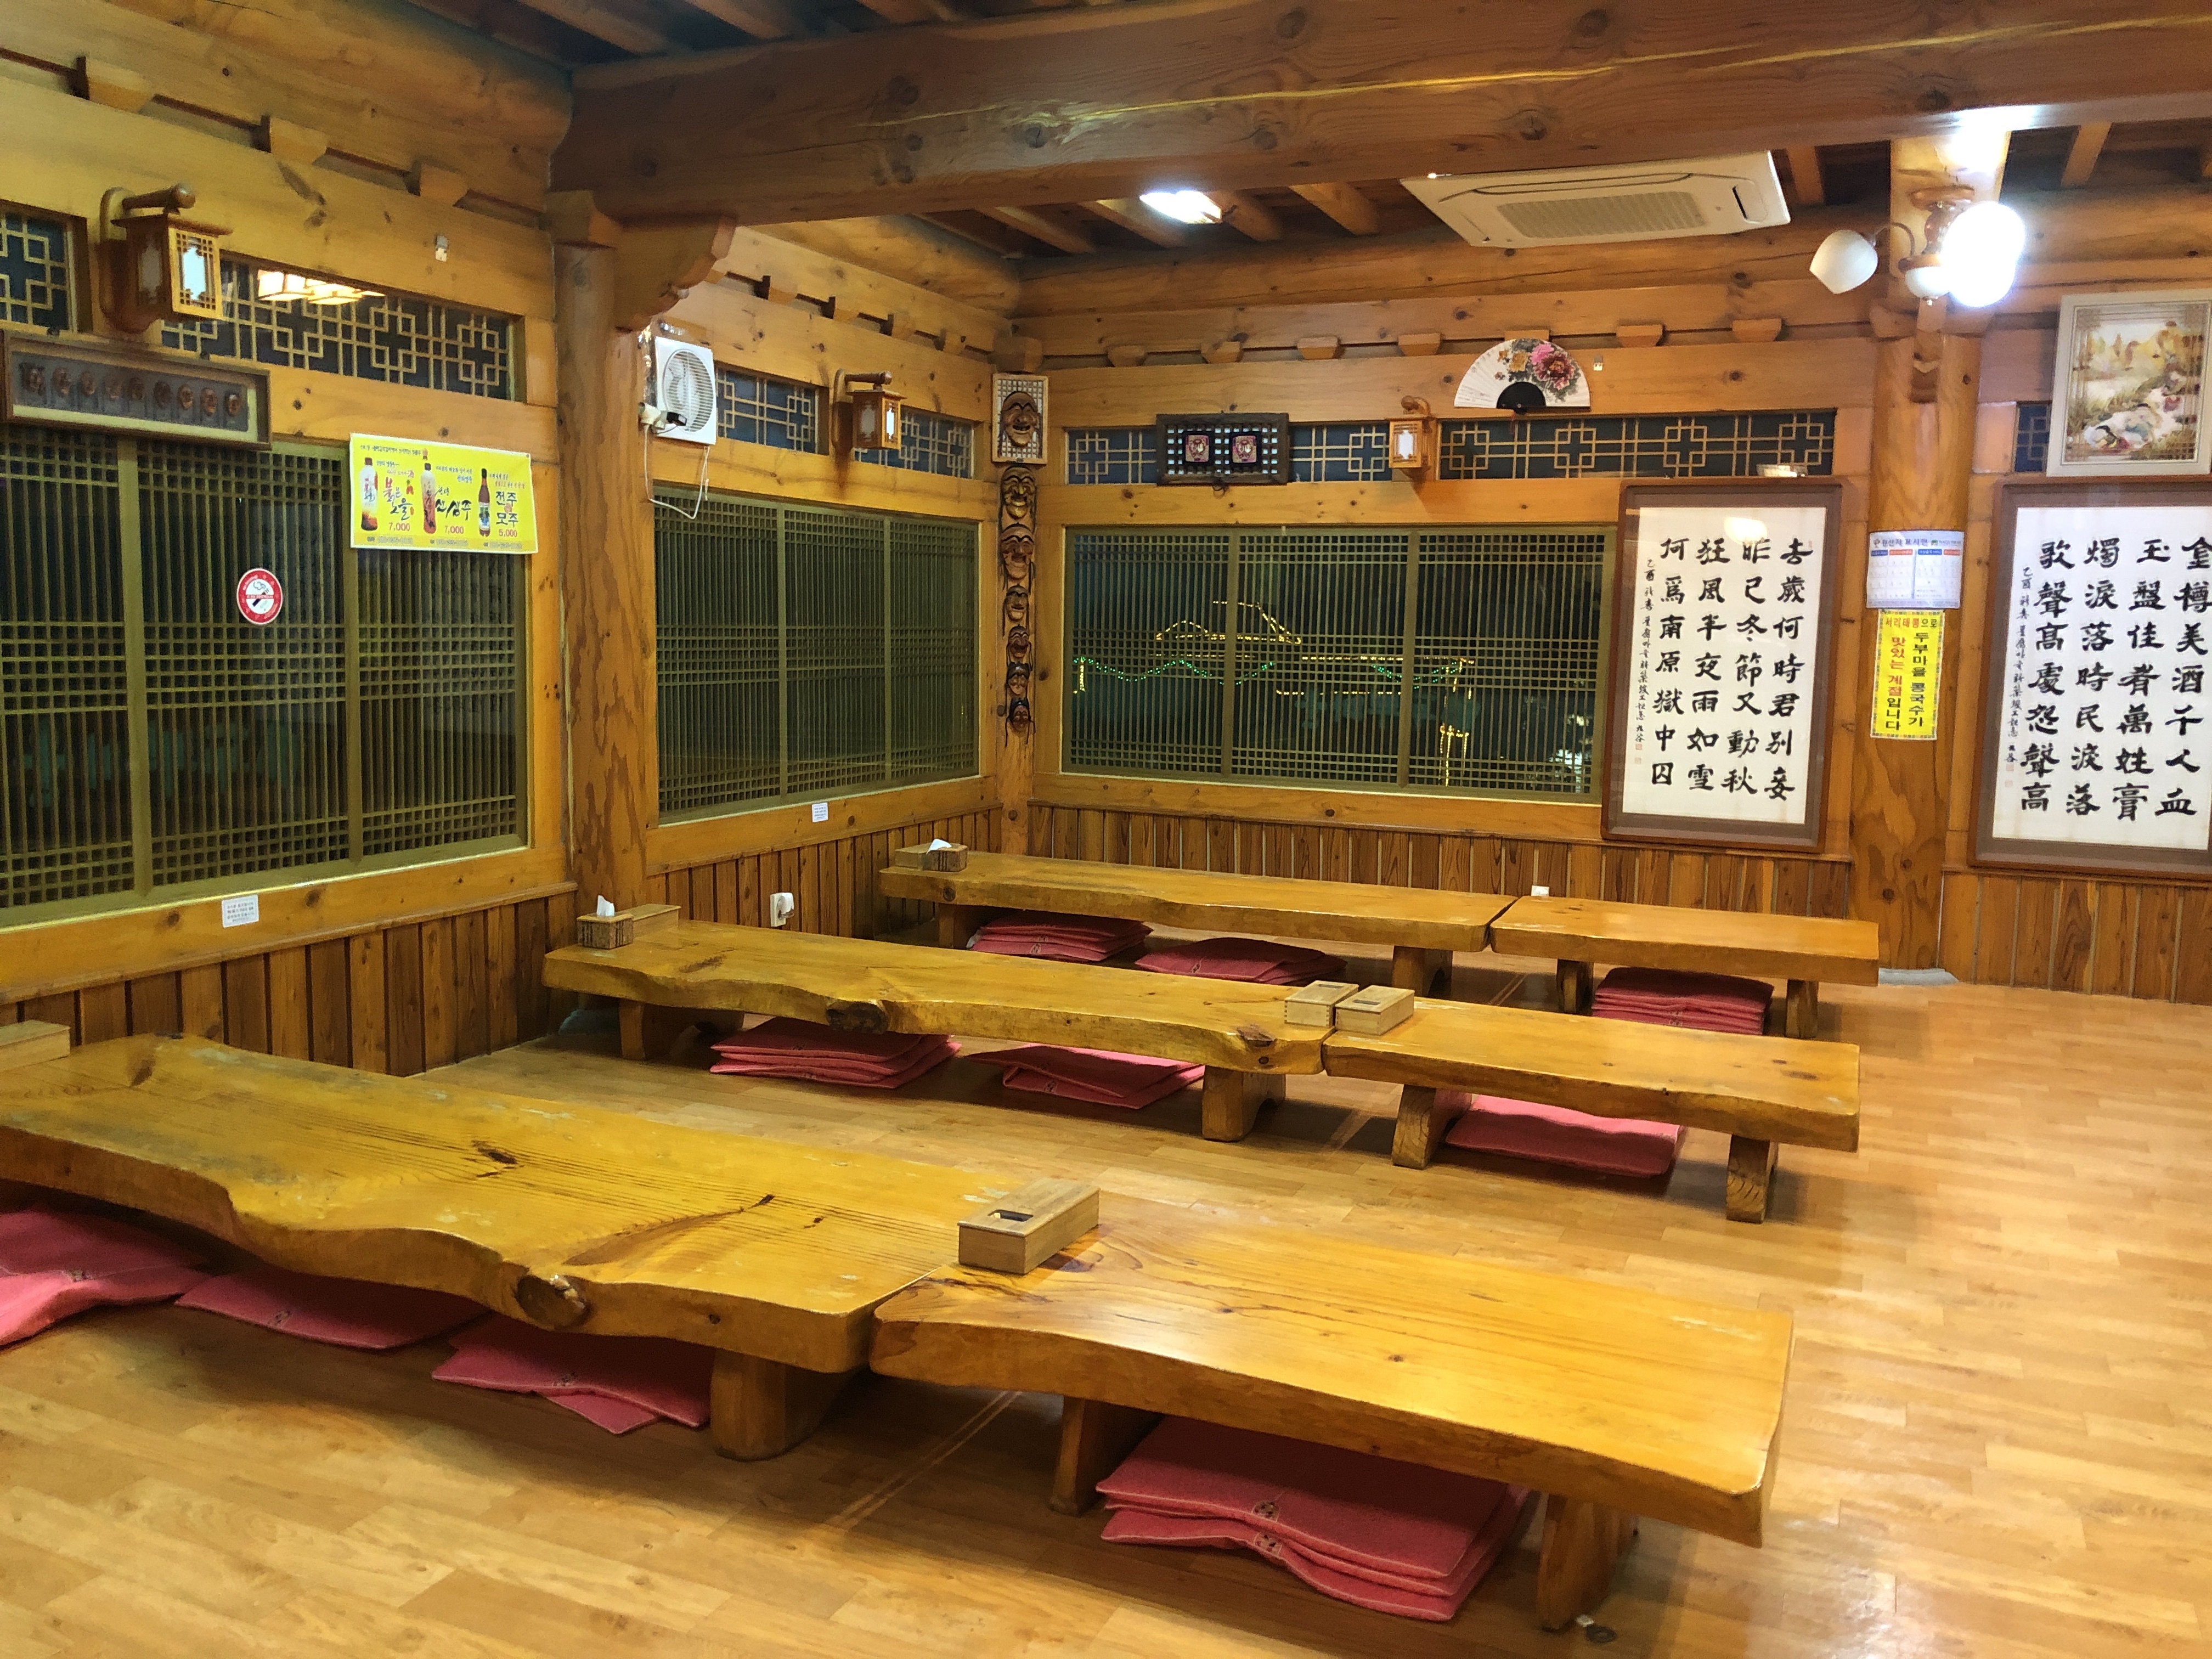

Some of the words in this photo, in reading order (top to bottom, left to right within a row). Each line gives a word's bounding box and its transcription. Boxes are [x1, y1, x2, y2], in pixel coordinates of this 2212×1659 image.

[496, 491, 517, 507] 전주
[389, 522, 410, 531] 7,000
[496, 512, 518, 528] 모주
[444, 525, 464, 534] 7,000
[499, 528, 517, 537] 5,000
[1889, 637, 1906, 669] 맛있는
[1912, 633, 1929, 677] 두부마을
[1886, 675, 1902, 730] 계절입니다
[1909, 682, 1925, 727] 콩국수가
